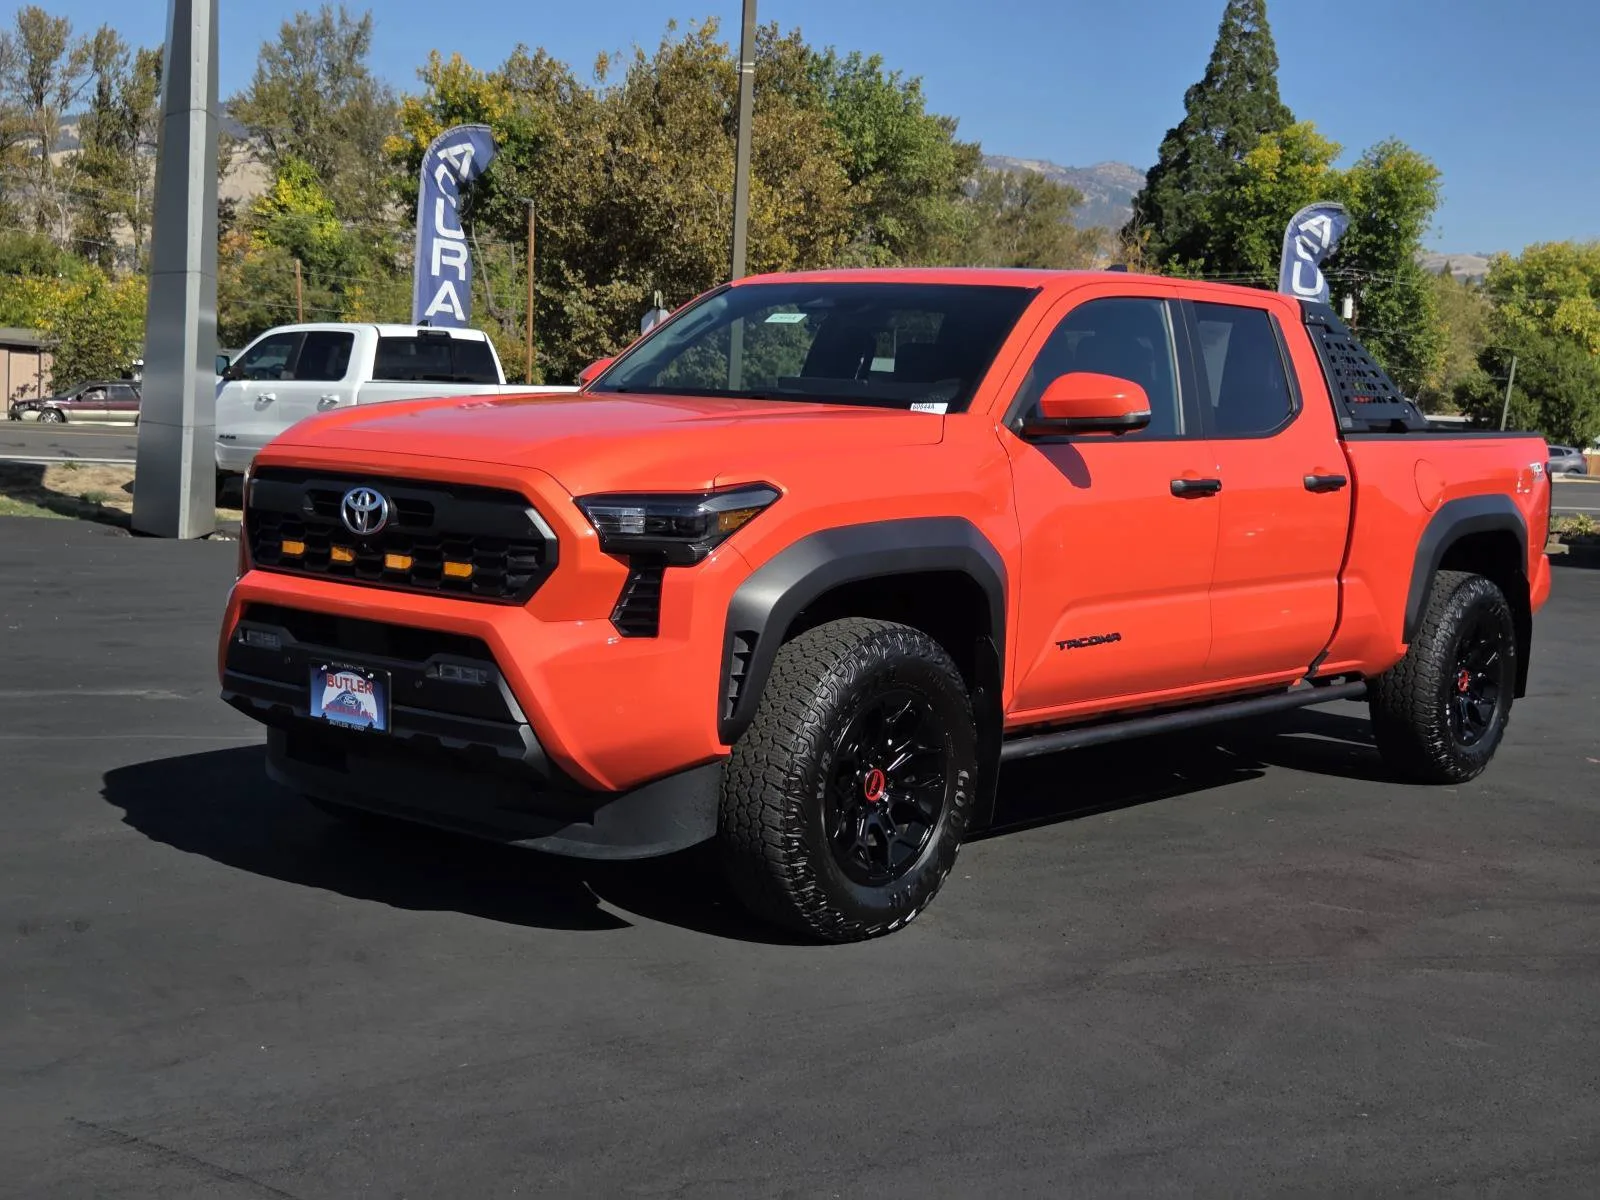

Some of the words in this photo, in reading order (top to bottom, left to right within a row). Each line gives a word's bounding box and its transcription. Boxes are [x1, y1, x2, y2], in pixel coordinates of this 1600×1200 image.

[424, 142, 476, 322] ACURA
[1291, 214, 1332, 301] ACU
[1055, 632, 1122, 651] TACOMA
[327, 673, 373, 694] BUTLER
